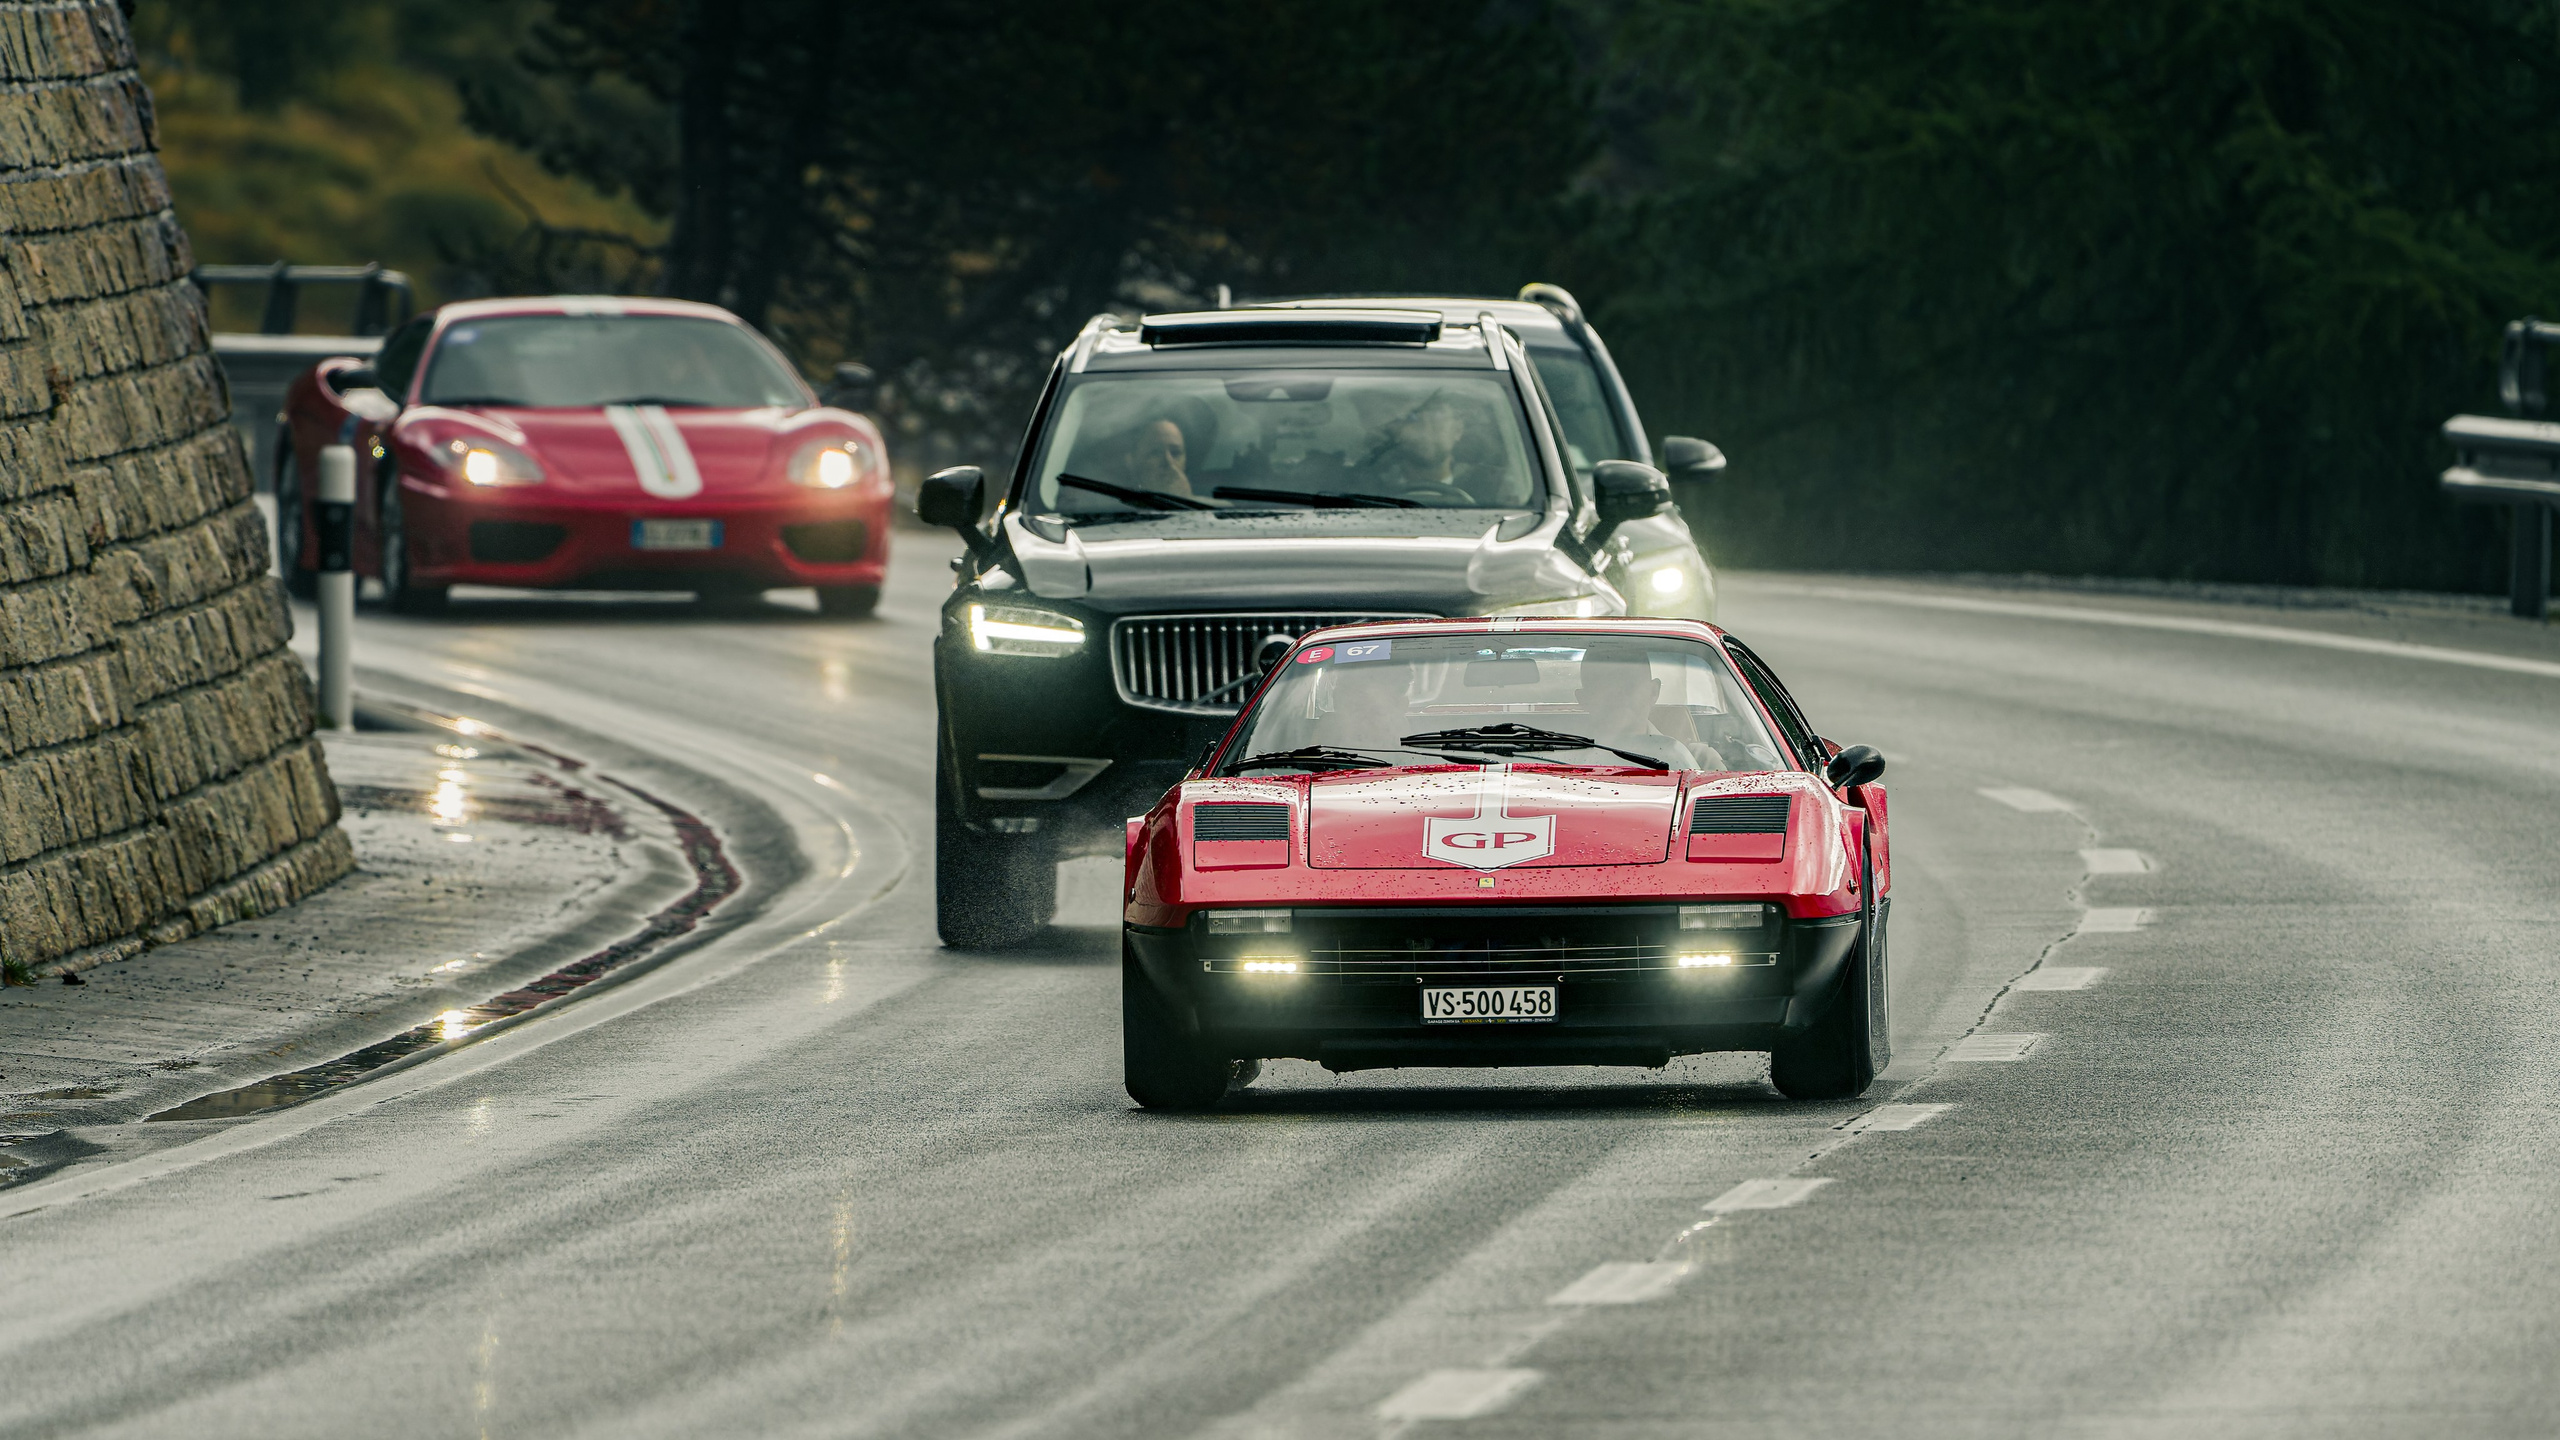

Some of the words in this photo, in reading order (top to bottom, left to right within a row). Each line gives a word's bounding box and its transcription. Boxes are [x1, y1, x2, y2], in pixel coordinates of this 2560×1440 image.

[1309, 649, 1324, 659] E
[1346, 645, 1380, 656] 67
[1441, 832, 1537, 849] GP
